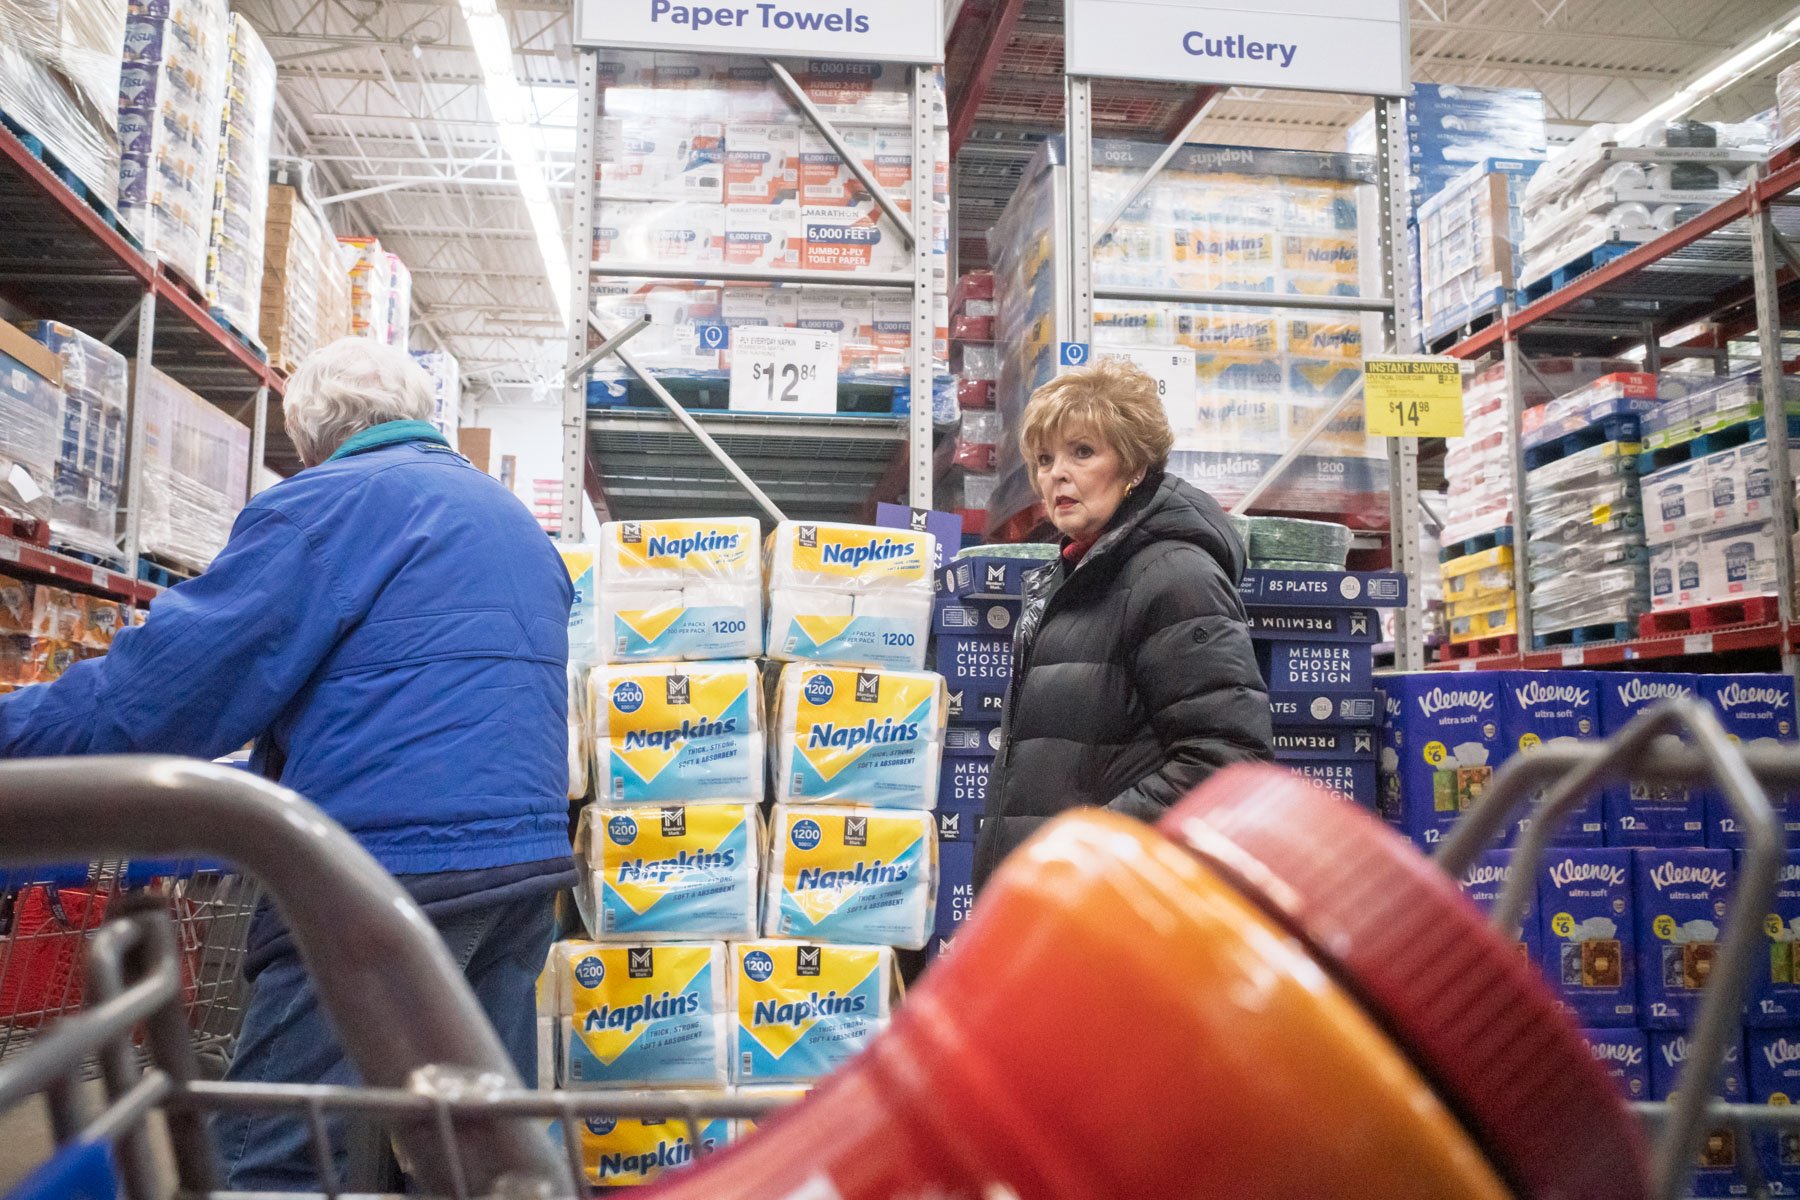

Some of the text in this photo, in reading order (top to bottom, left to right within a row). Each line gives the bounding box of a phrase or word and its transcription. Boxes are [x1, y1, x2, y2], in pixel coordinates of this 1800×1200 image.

[651, 0, 869, 33] Paper Towels
[1183, 31, 1297, 68] Cutlery
[810, 62, 872, 75] 6,000 FEET
[728, 152, 767, 161] 6,000 FEET
[804, 154, 824, 162] 6,000
[1105, 151, 1134, 161] 1200
[1190, 149, 1254, 166] Napkins
[806, 209, 860, 218] MARATHON
[729, 233, 768, 241] 6,000 FEET
[808, 227, 872, 240] 6,000 FEET
[808, 247, 864, 255] JUMBO 2-PLY
[1196, 235, 1264, 256] Napkins
[808, 256, 866, 265] TOILET PAPER
[801, 320, 840, 329] 6,000 FEET
[1369, 362, 1455, 373] INSTANT SAVINGS
[1193, 457, 1260, 479] Napkins
[1317, 461, 1344, 474] 1200
[648, 531, 739, 559] Napkins
[823, 539, 915, 568] Napkins
[1269, 580, 1328, 592] 85 PLATES
[712, 621, 746, 633] 1200
[1262, 618, 1333, 629] PREMIUM
[882, 633, 915, 646] 1200
[957, 641, 1014, 653] MEMBE
[1289, 648, 1350, 659] MEMBER
[1289, 660, 1350, 671] CHOSEN
[1289, 672, 1350, 683] DESIGN
[806, 684, 832, 695] 1200
[1516, 680, 1589, 709] Kleenex
[1618, 678, 1691, 707] Kleenex
[614, 691, 642, 702] 1200
[1419, 687, 1494, 717] Kleenex
[1717, 683, 1789, 710] Kleenex
[1270, 703, 1297, 713] ATES
[1535, 709, 1573, 718] ultra soft
[1439, 715, 1478, 725] ultra soft
[1736, 711, 1774, 720] ultra soft
[625, 717, 736, 751] Napkins
[809, 718, 918, 751] Napkins
[678, 749, 737, 768] SOFT ABSORBENT
[857, 757, 915, 768] SOFT ABSORBENT
[955, 763, 989, 774] MEM
[1290, 766, 1353, 777] MEMBER
[954, 775, 987, 787] CHO
[955, 788, 986, 799] DES
[1620, 816, 1636, 830] 12
[1720, 819, 1736, 832] 12
[609, 825, 636, 835] 1200
[793, 829, 820, 840] 1200
[1424, 829, 1440, 843] 12
[618, 849, 735, 883] Napkins
[797, 860, 909, 892] Napkins
[1550, 859, 1625, 888] Kleenex
[1651, 862, 1726, 891] Kleenex
[673, 885, 735, 900] SOFT ABSORBENT
[1472, 892, 1493, 900] ultra
[1569, 889, 1608, 897] ultra soft
[1670, 892, 1708, 900] ultra soft
[846, 899, 904, 914] SOFT ABSORBENT
[576, 966, 603, 978] 1200
[745, 960, 772, 972] 1200
[585, 991, 698, 1032] Napkins
[754, 991, 865, 1026] Napkins
[1651, 1003, 1667, 1017] 12
[1760, 1000, 1775, 1014] 12
[650, 1027, 672, 1038] THICK,
[809, 1029, 867, 1045] SOFT ABSORBENT
[639, 1031, 702, 1051] SOFT ABSORBENT
[1764, 1038, 1800, 1068] Klee
